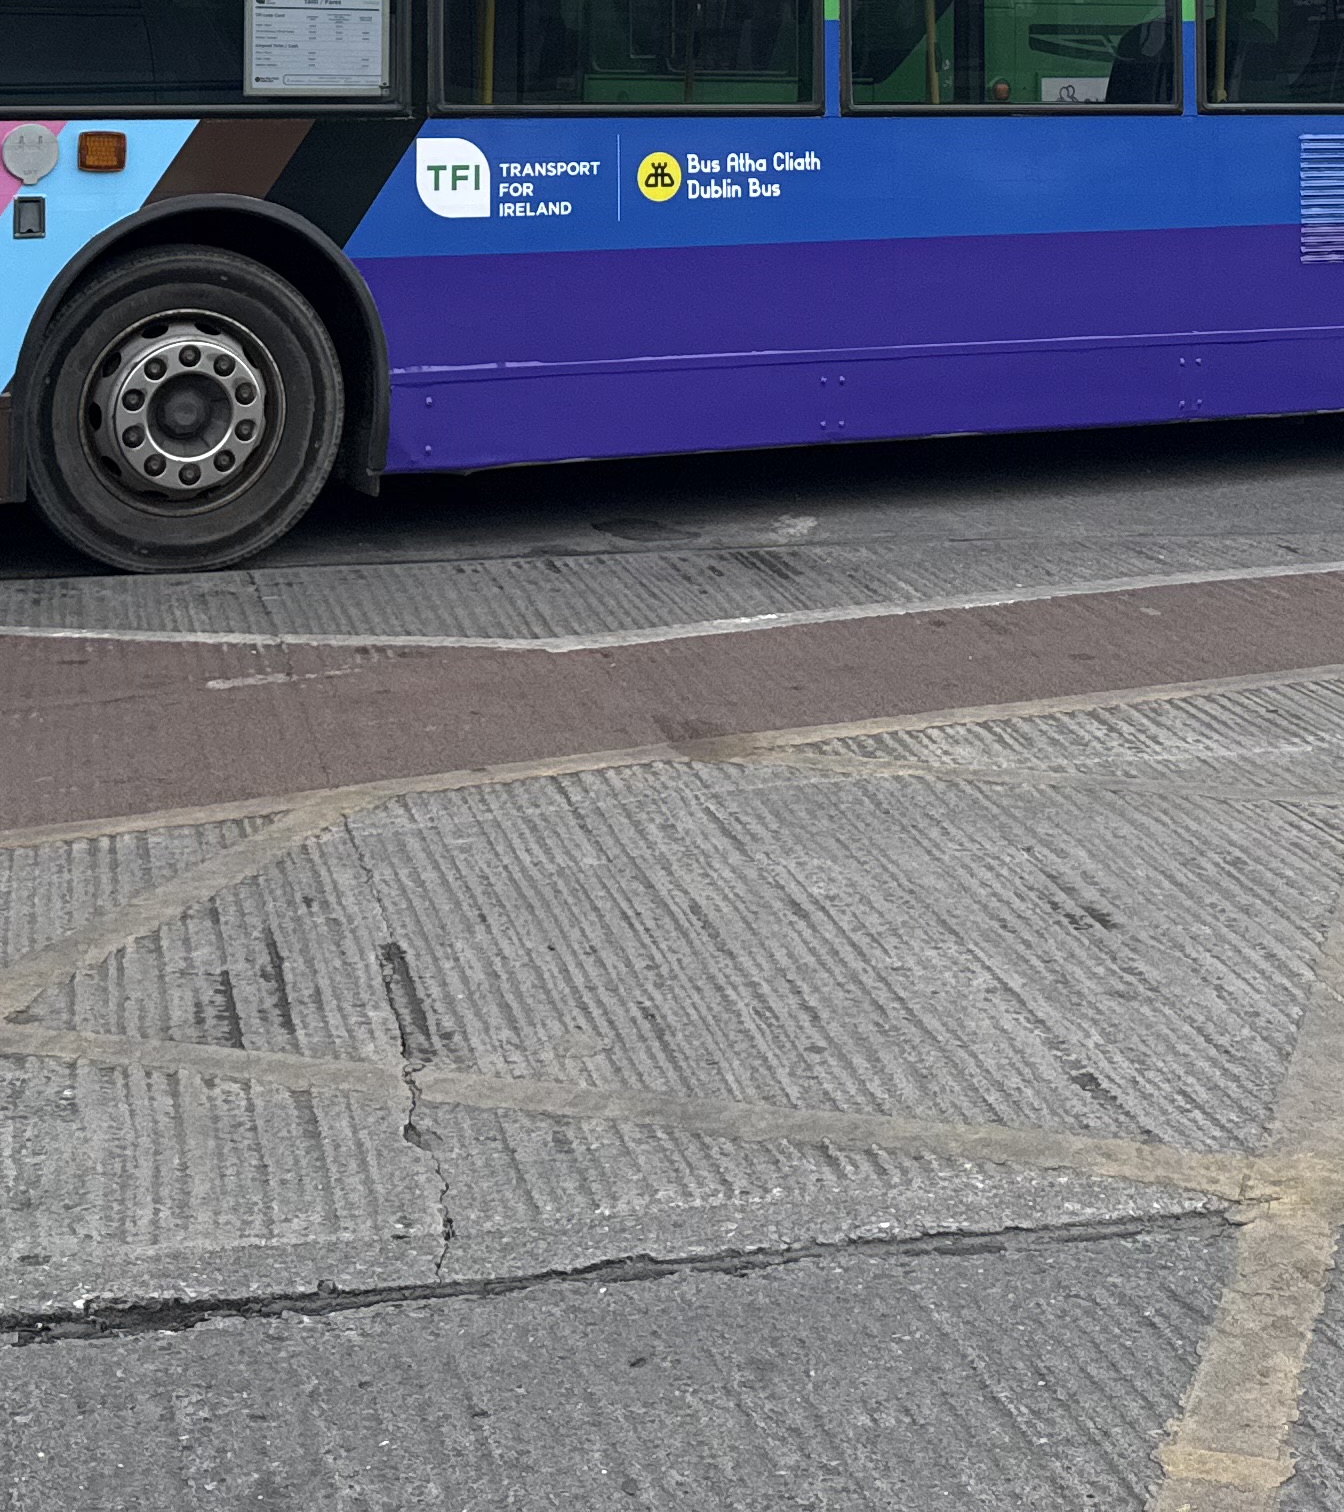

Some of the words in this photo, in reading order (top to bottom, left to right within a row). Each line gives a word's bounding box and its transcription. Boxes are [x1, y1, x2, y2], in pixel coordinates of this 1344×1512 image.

[499, 161, 601, 178] TRANSPORT
[687, 154, 722, 174] Bus
[773, 151, 821, 171] Cliath
[426, 165, 481, 191] TFI
[499, 182, 534, 197] FOR
[687, 178, 742, 201] Dublin
[748, 178, 781, 198] Bus
[499, 200, 572, 217] IRELAND
